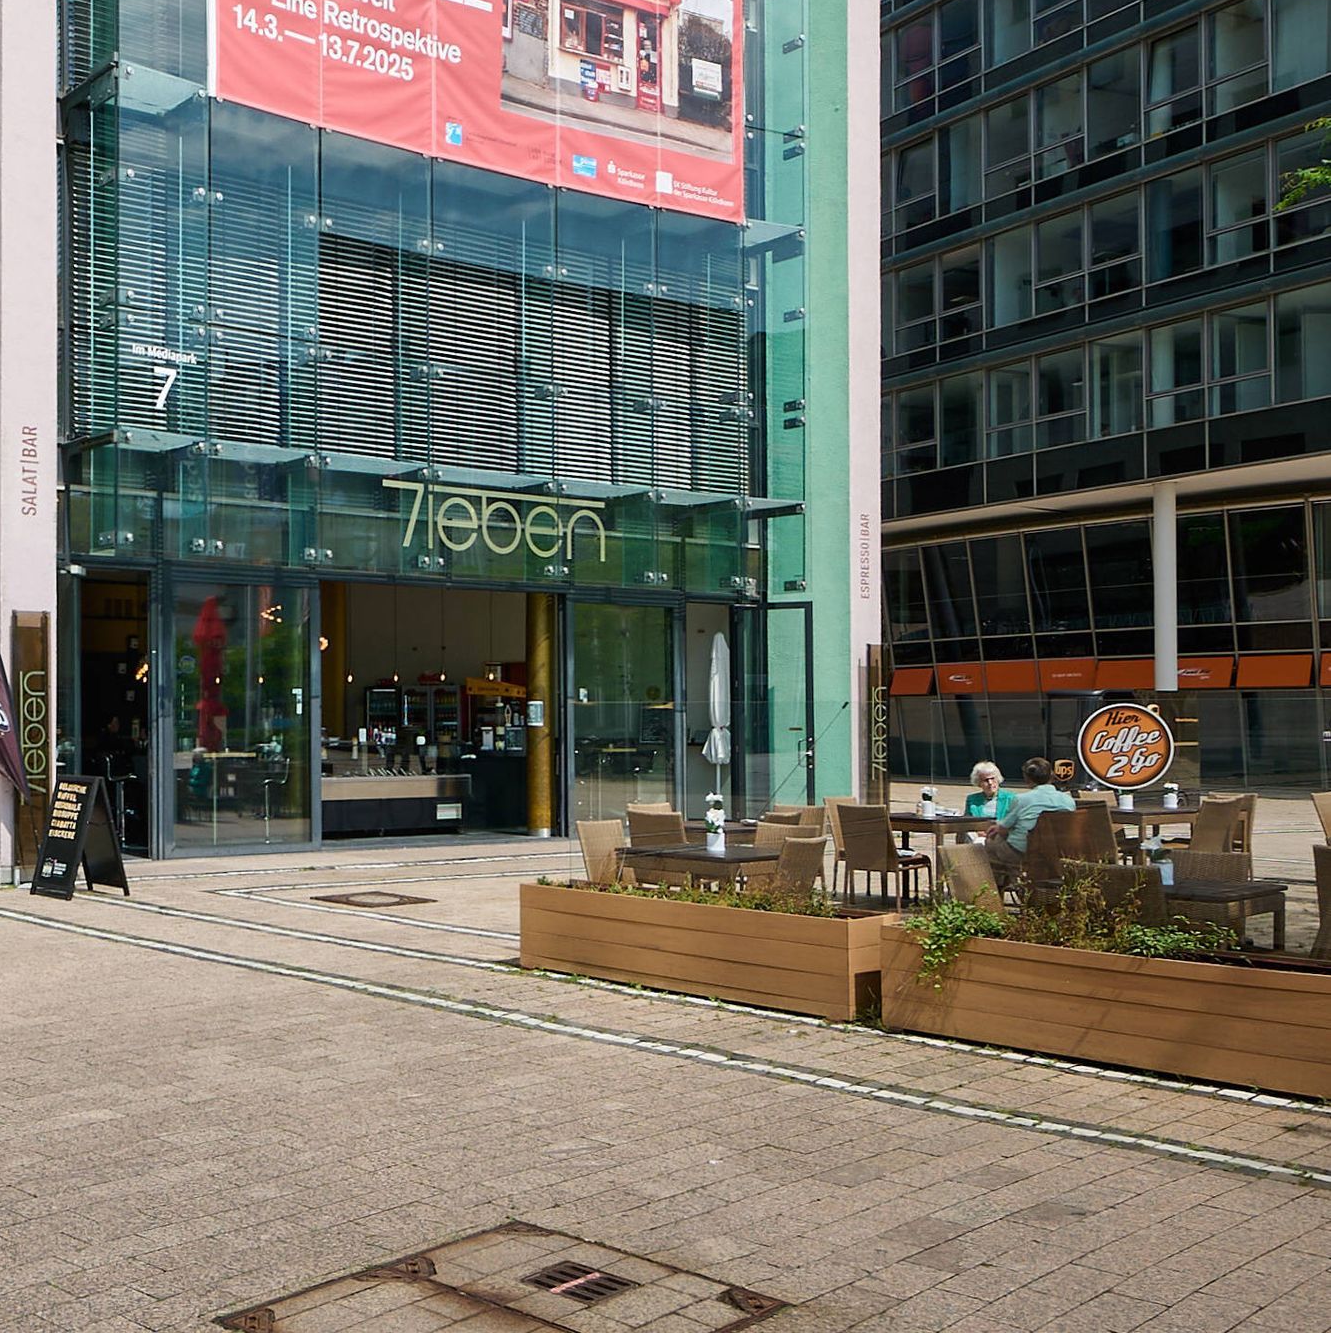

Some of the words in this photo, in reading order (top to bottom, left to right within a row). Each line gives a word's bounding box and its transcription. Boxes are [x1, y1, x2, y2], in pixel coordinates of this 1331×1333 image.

[323, 0, 463, 65] Retrospektive
[131, 343, 146, 356] Im
[153, 365, 178, 410] 7
[382, 478, 606, 563] 7ieben
[1104, 710, 1141, 727] Hier
[1089, 725, 1162, 754] Coffee
[1055, 765, 1073, 778] ups
[1105, 754, 1129, 778] 2
[1130, 747, 1163, 775] Go
